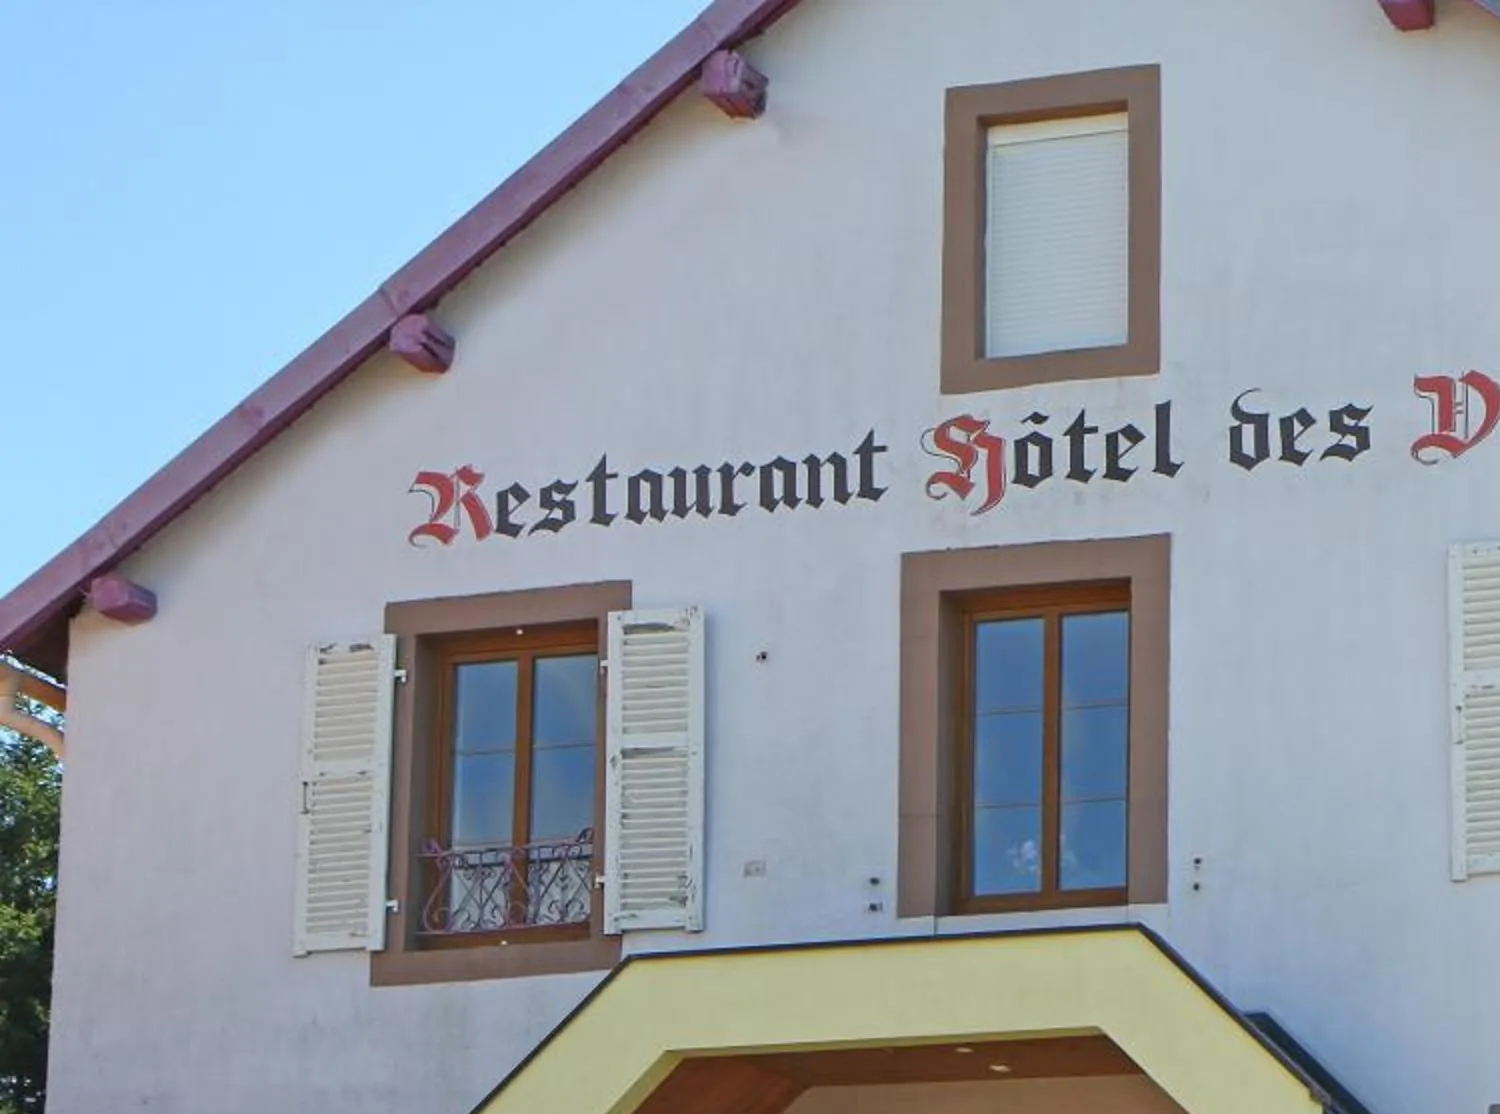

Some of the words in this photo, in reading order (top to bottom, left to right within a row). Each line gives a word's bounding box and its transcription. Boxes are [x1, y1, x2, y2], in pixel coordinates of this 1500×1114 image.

[409, 429, 889, 547] Restaurant
[920, 399, 1185, 516] Hôtel
[1229, 387, 1374, 471] des
